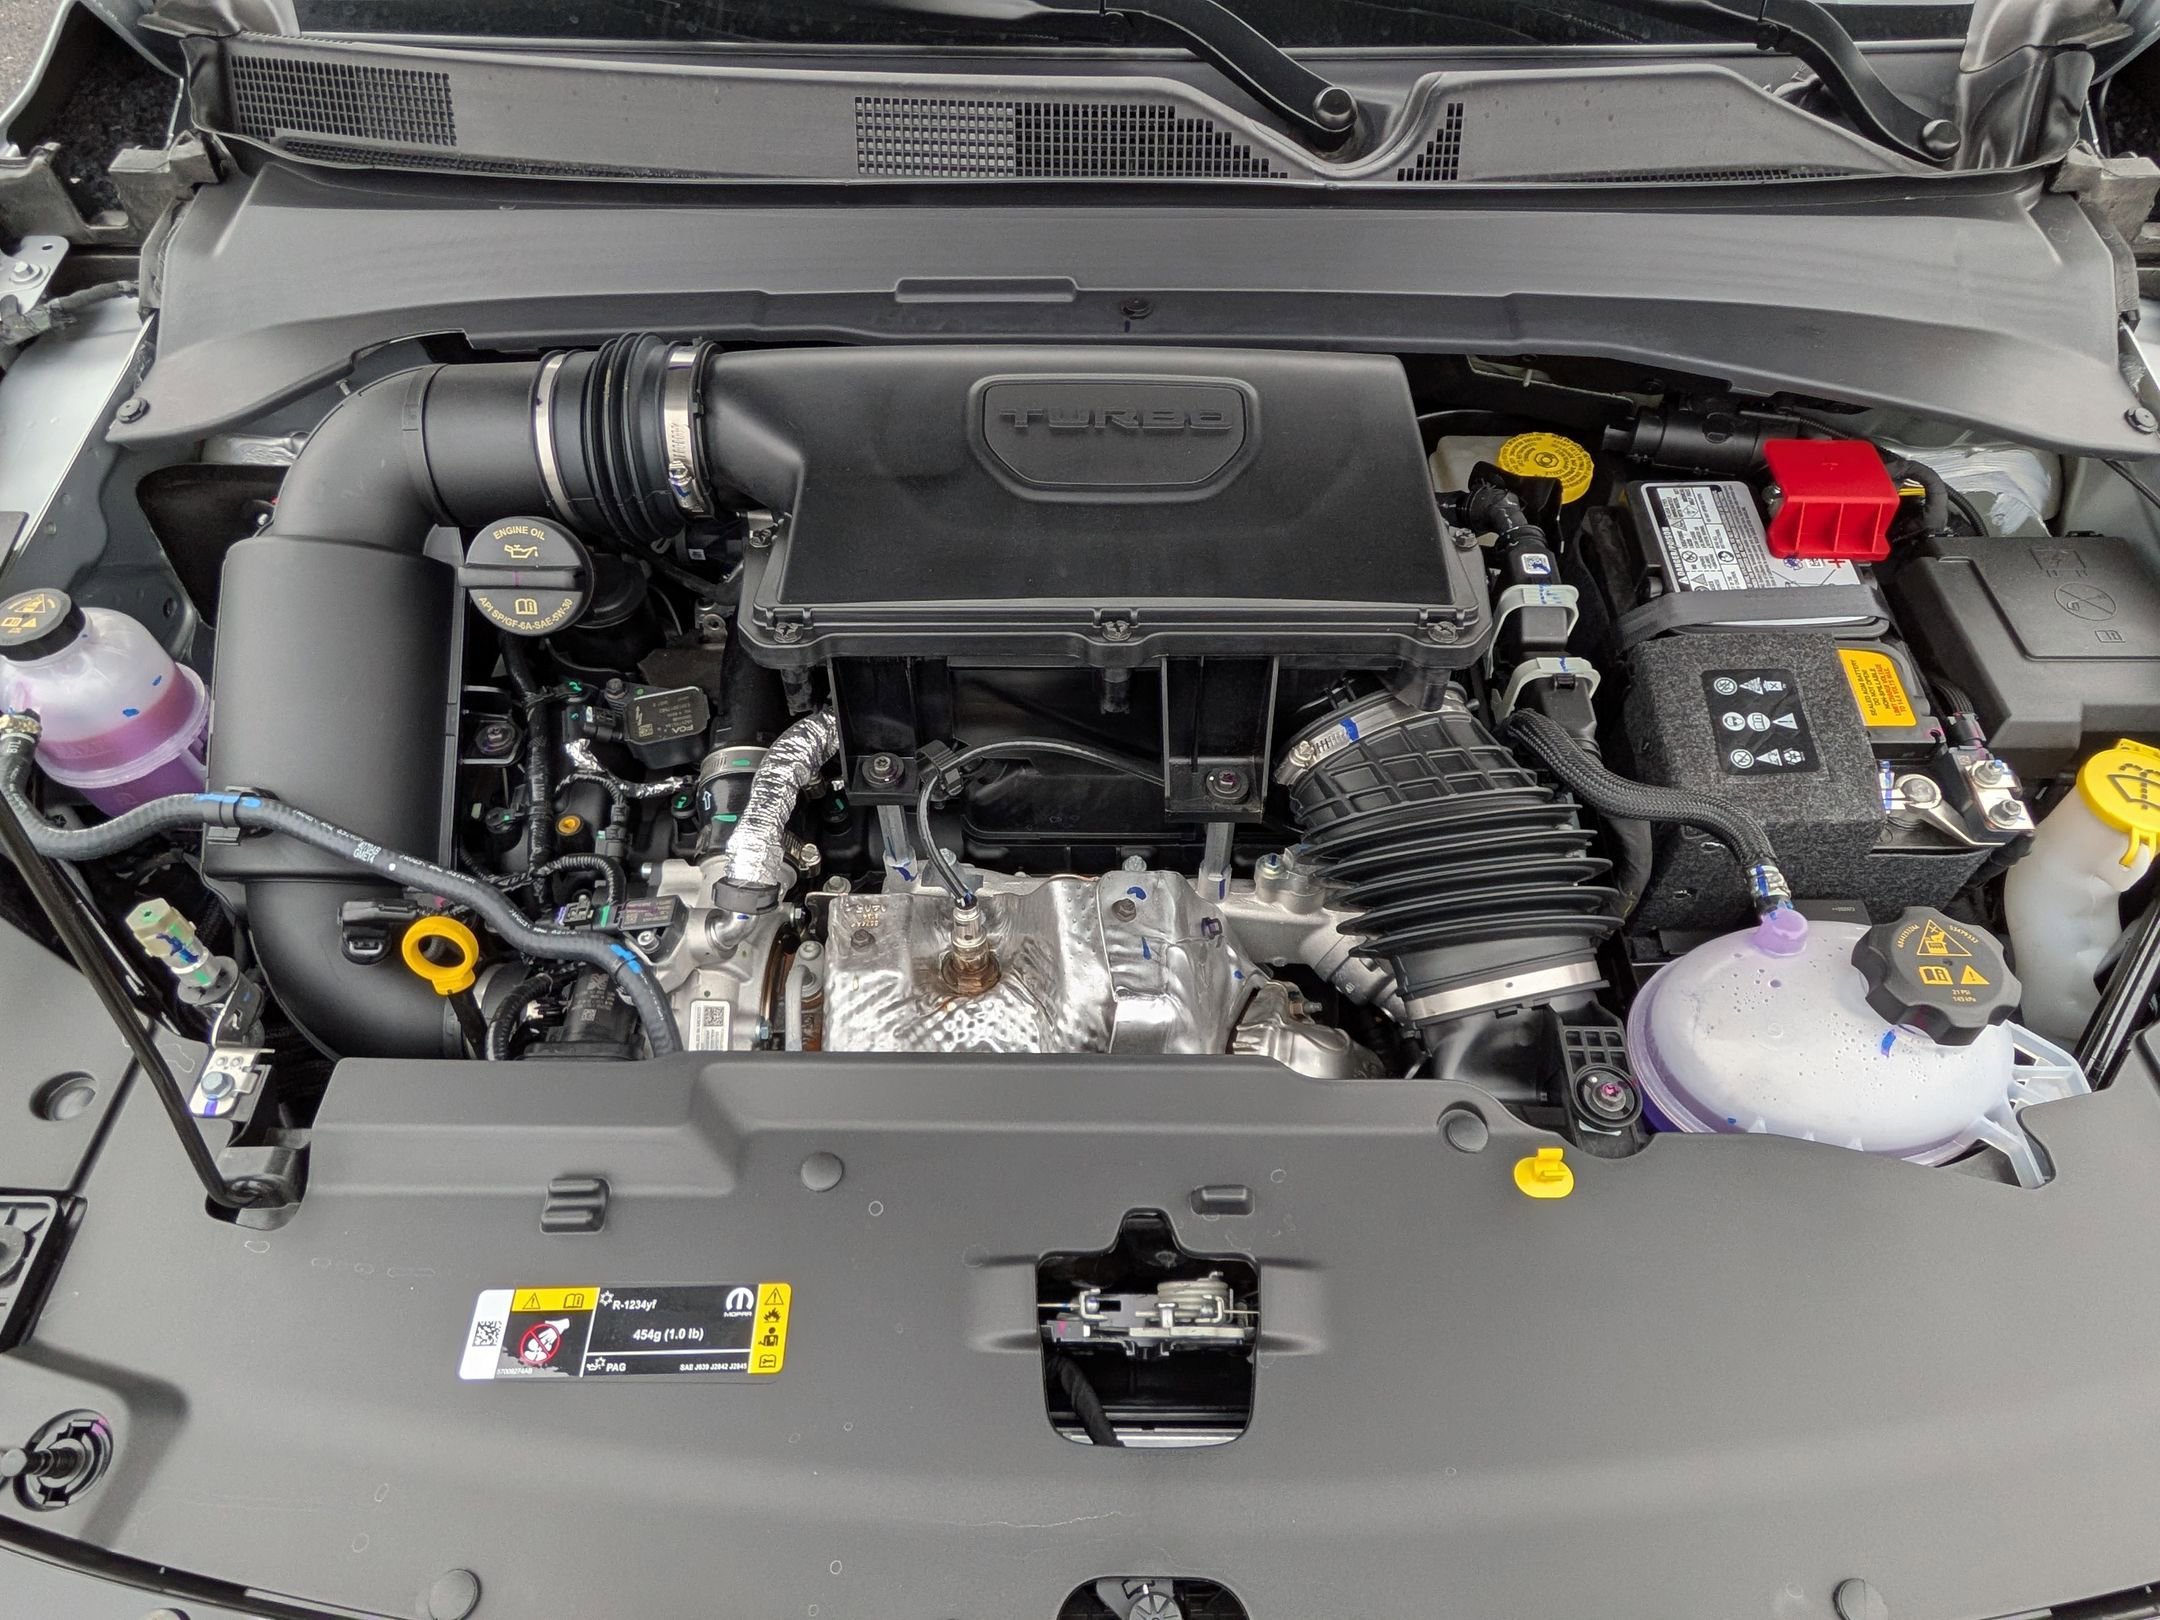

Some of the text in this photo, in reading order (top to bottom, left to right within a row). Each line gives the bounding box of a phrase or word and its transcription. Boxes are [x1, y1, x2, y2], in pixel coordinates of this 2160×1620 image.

[1000, 408, 1232, 429] TURBO
[493, 526, 546, 541] ENGINE OIL
[1661, 526, 1685, 576] DANGER/POISON
[479, 597, 494, 612] API
[1851, 659, 1862, 681] BATTERY
[672, 724, 694, 735] FCA
[612, 1299, 657, 1311] R-1234yf
[633, 1328, 704, 1342] 454g (1.0 lb)
[606, 1363, 627, 1372] PAG
[680, 1363, 693, 1371] SAE
